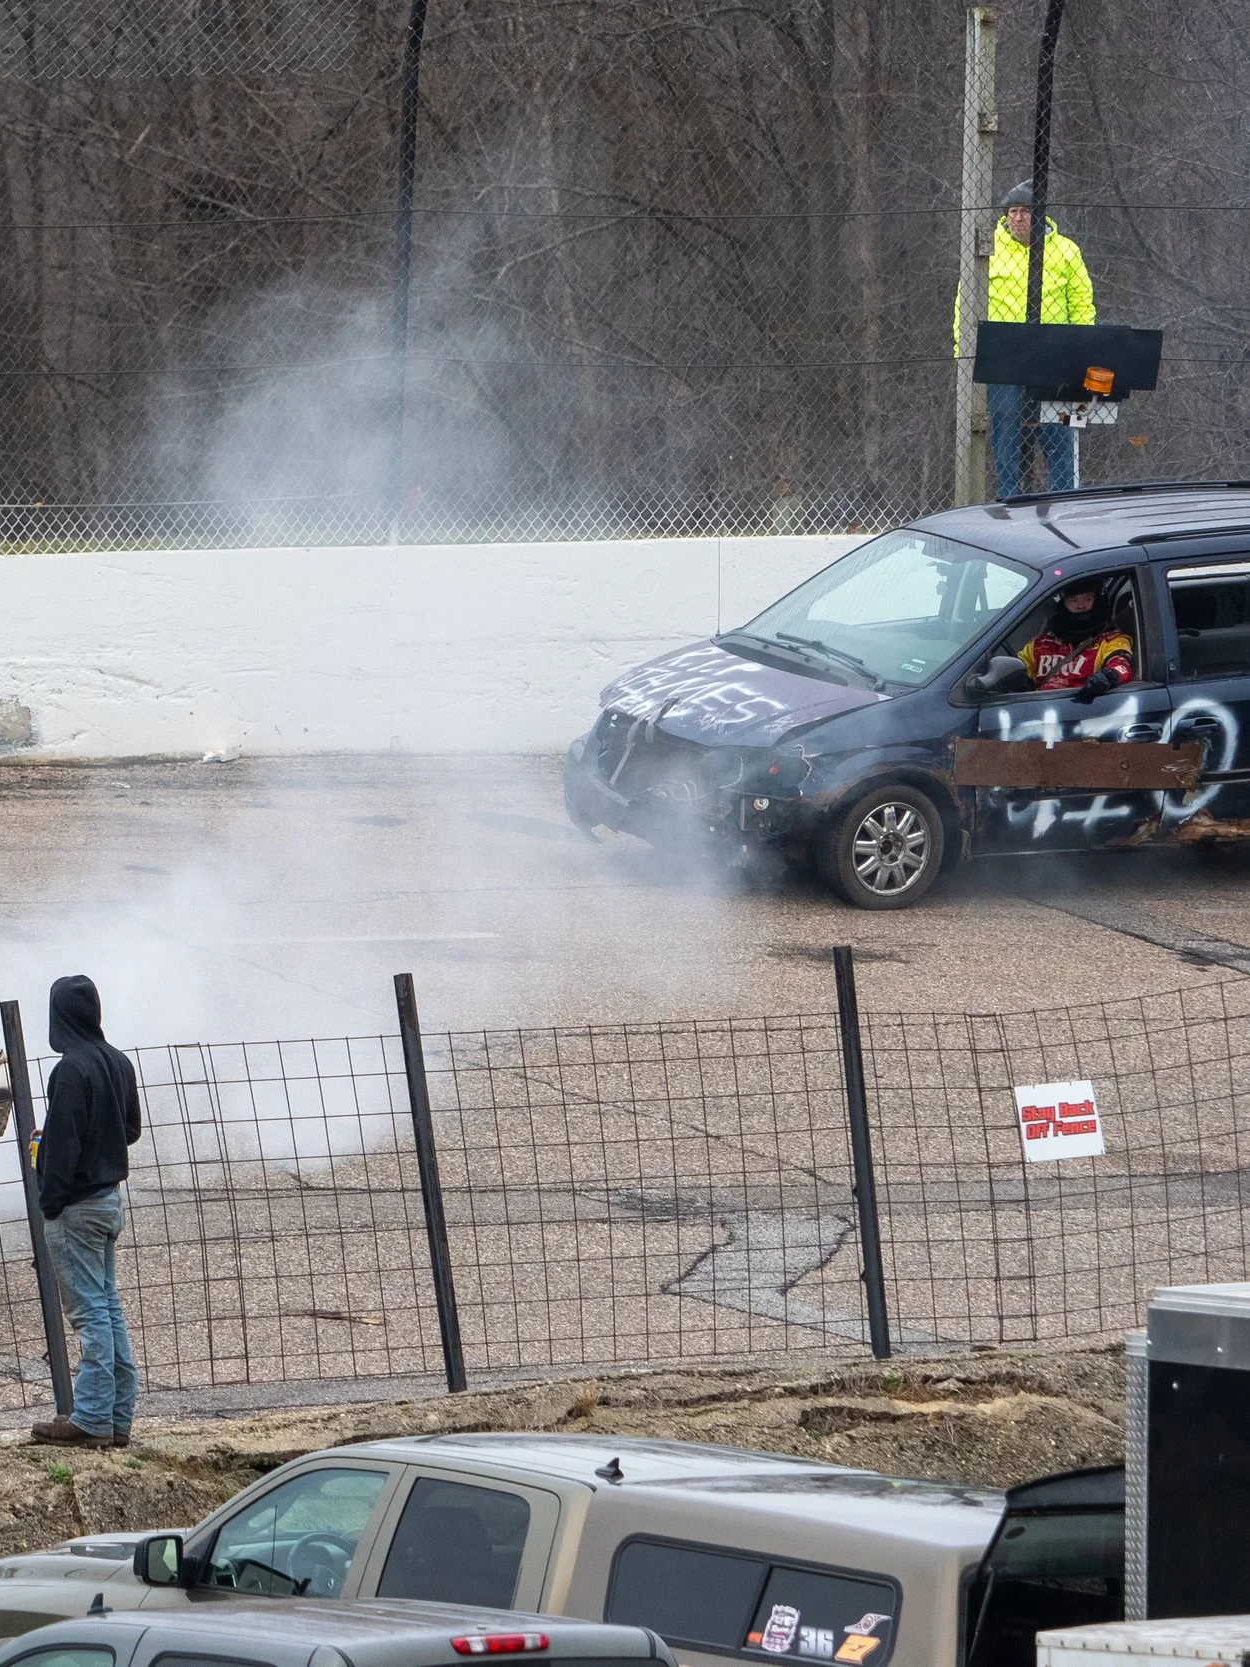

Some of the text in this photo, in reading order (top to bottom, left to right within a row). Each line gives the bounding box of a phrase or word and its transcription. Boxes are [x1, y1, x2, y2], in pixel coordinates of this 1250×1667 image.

[616, 667, 788, 724] JAMES
[1022, 1099, 1095, 1123] Stay Back
[1026, 1119, 1096, 1140] Off Fence
[799, 1625, 834, 1659] 36
